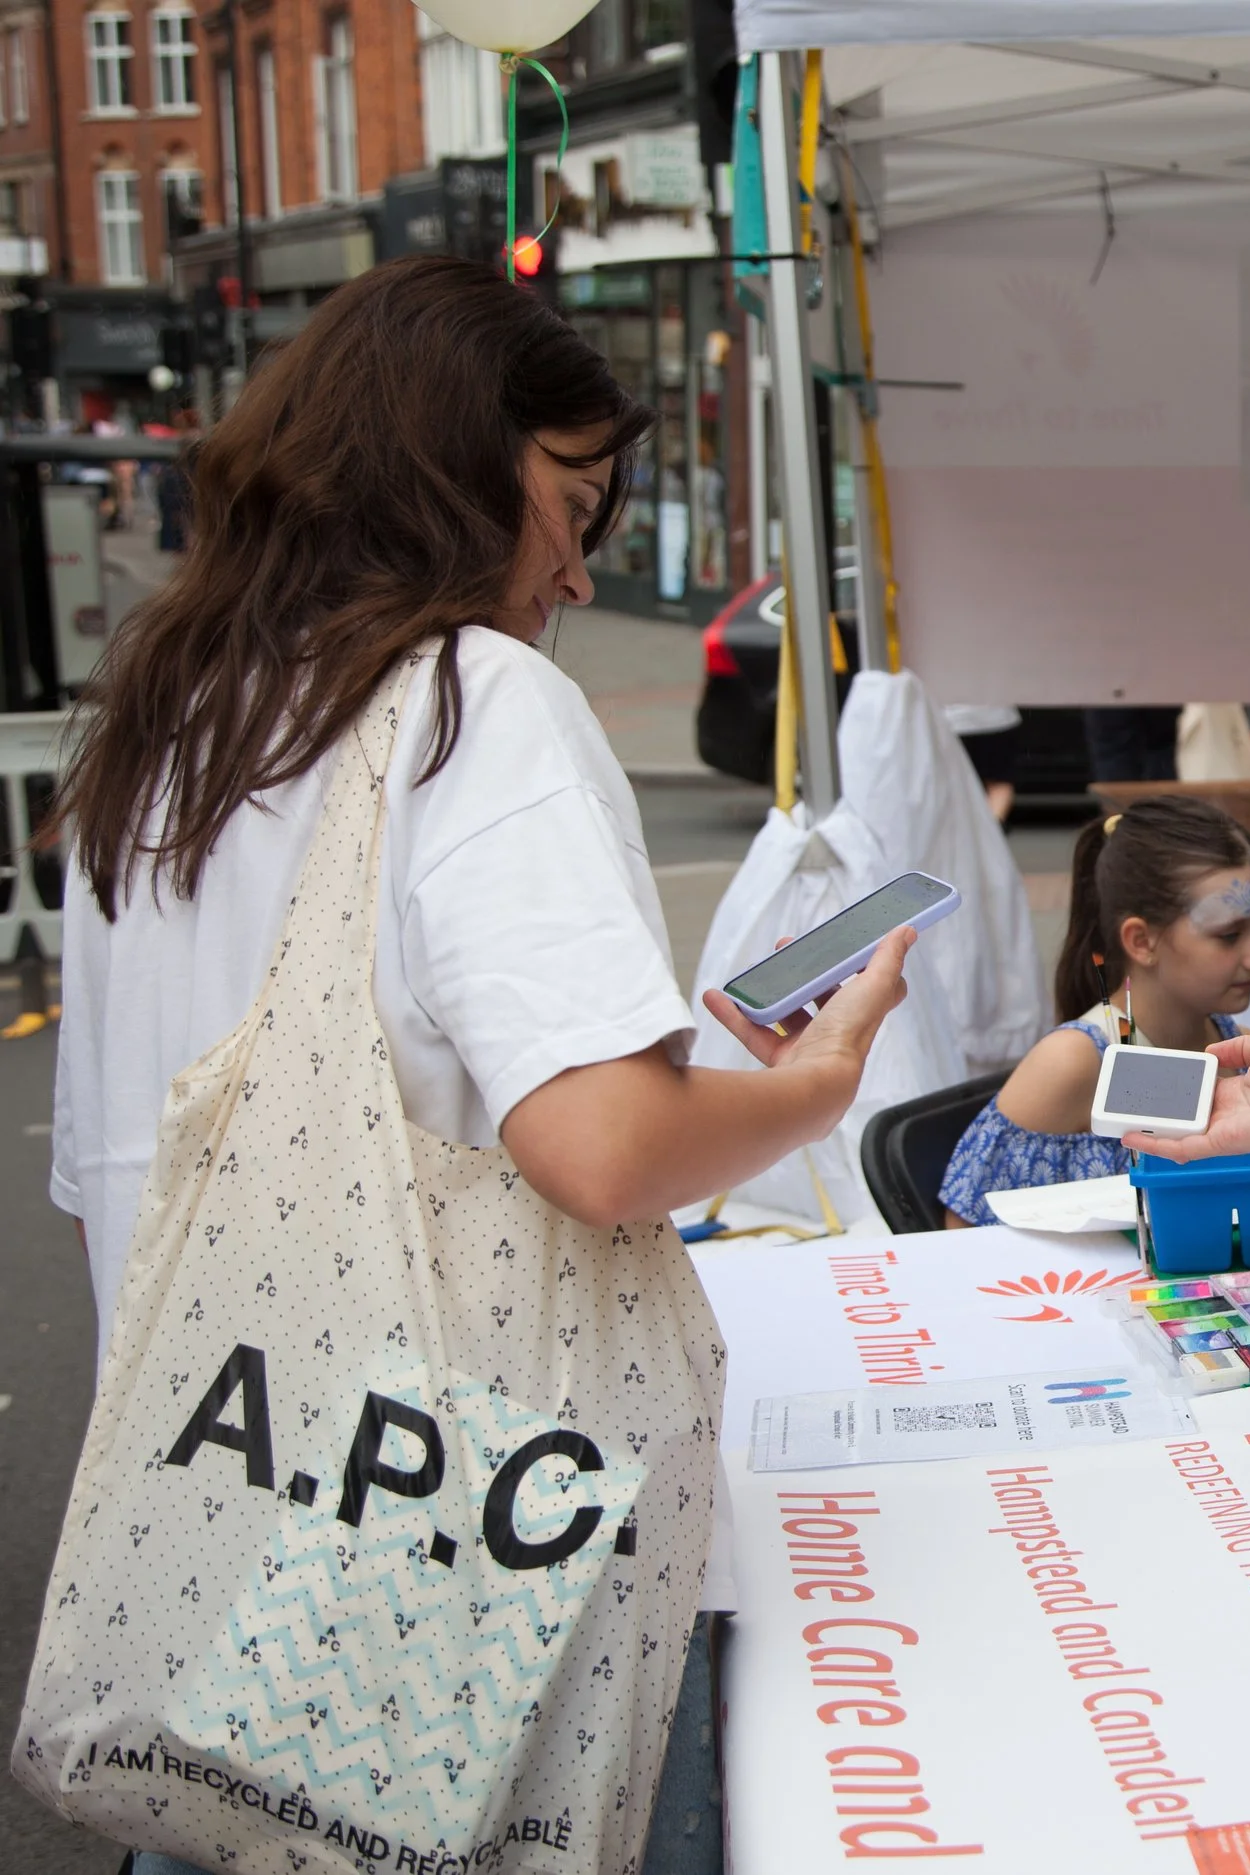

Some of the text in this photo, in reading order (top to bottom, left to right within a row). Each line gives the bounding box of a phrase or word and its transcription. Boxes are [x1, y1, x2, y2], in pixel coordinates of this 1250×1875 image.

[827, 1251, 945, 1385] Time to Thriv
[1008, 1384, 1026, 1398] Scan
[1013, 1406, 1031, 1426] donate
[1065, 1405, 1085, 1429] FESTIVAL
[1084, 1403, 1107, 1427] SUMMER
[1104, 1401, 1129, 1434] HAMPSTEAD
[1018, 1426, 1037, 1440] here
[165, 1342, 637, 1570] A.P.C.
[986, 1465, 1206, 1841] Hampstead and Camden
[777, 1491, 984, 1859] Home Care and
[88, 1741, 97, 1766] I
[104, 1747, 154, 1776] AM
[163, 1755, 319, 1831] RECYCLED
[326, 1818, 390, 1862] AND
